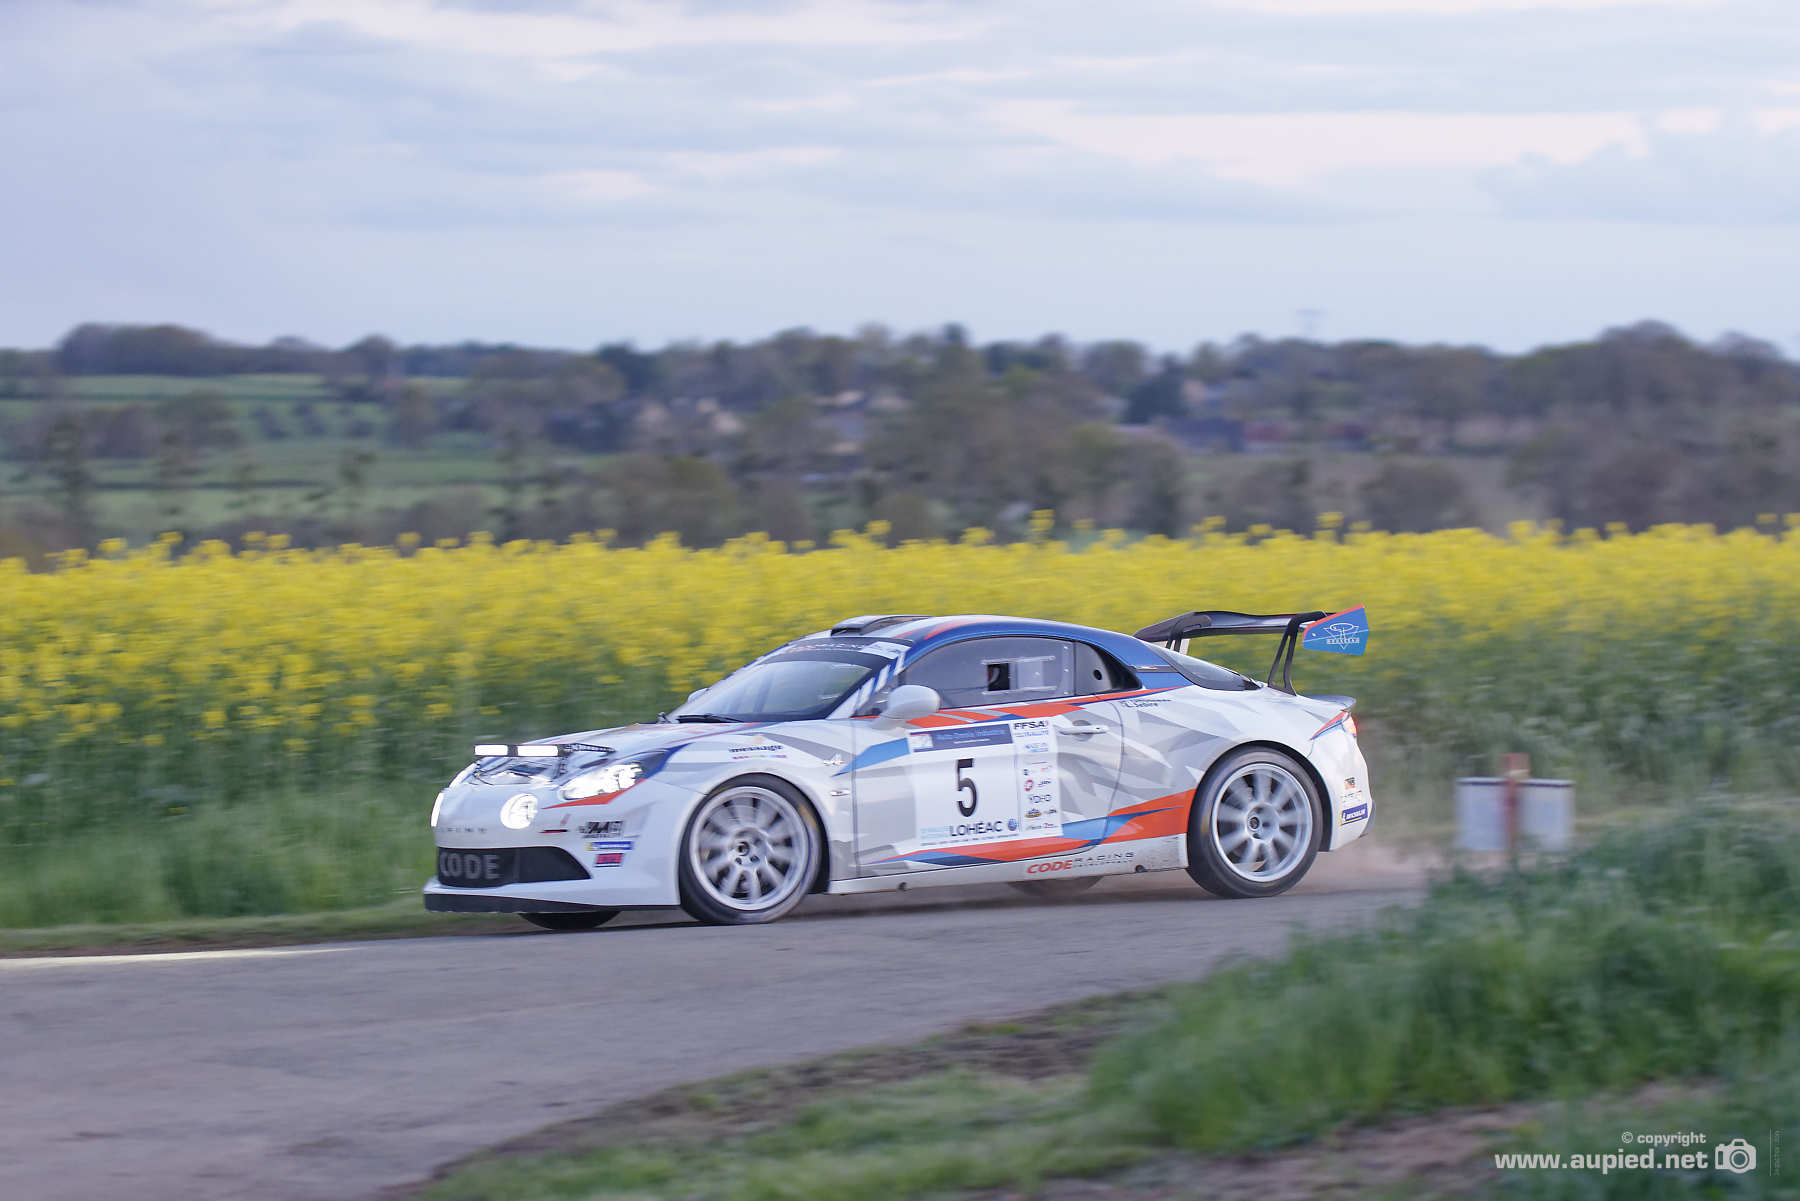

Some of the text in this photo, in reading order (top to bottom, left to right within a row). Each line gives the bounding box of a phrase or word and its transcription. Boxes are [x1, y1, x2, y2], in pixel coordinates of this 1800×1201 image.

[956, 758, 977, 817] 5
[439, 852, 501, 879] CODE
[1027, 860, 1072, 874] CODE
